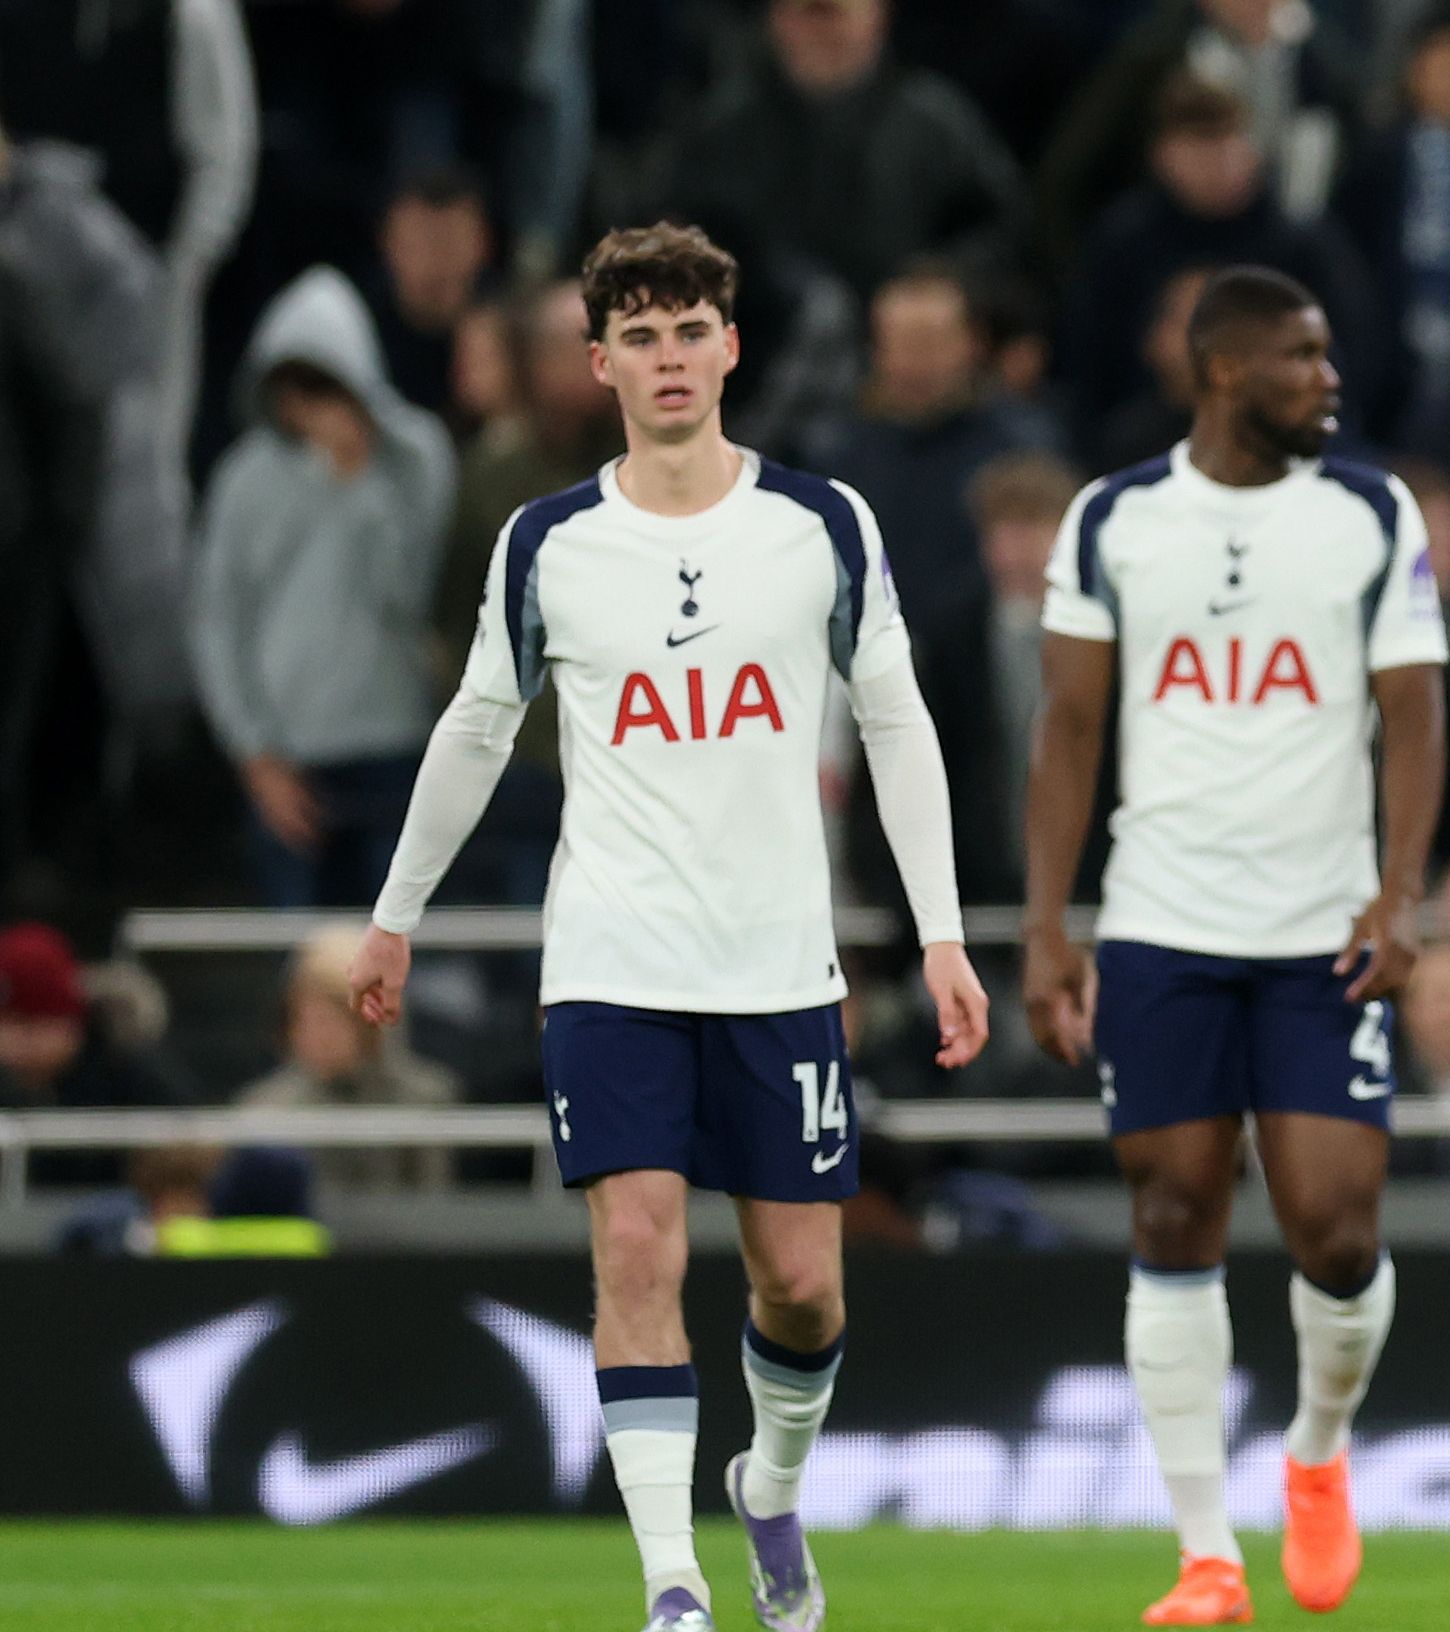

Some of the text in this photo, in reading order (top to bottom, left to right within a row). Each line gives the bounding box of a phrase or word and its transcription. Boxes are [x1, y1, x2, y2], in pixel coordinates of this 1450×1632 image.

[610, 662, 785, 746] AIA
[1152, 636, 1320, 706] AIA
[1350, 1000, 1392, 1078] 4
[792, 1060, 849, 1143] 14
